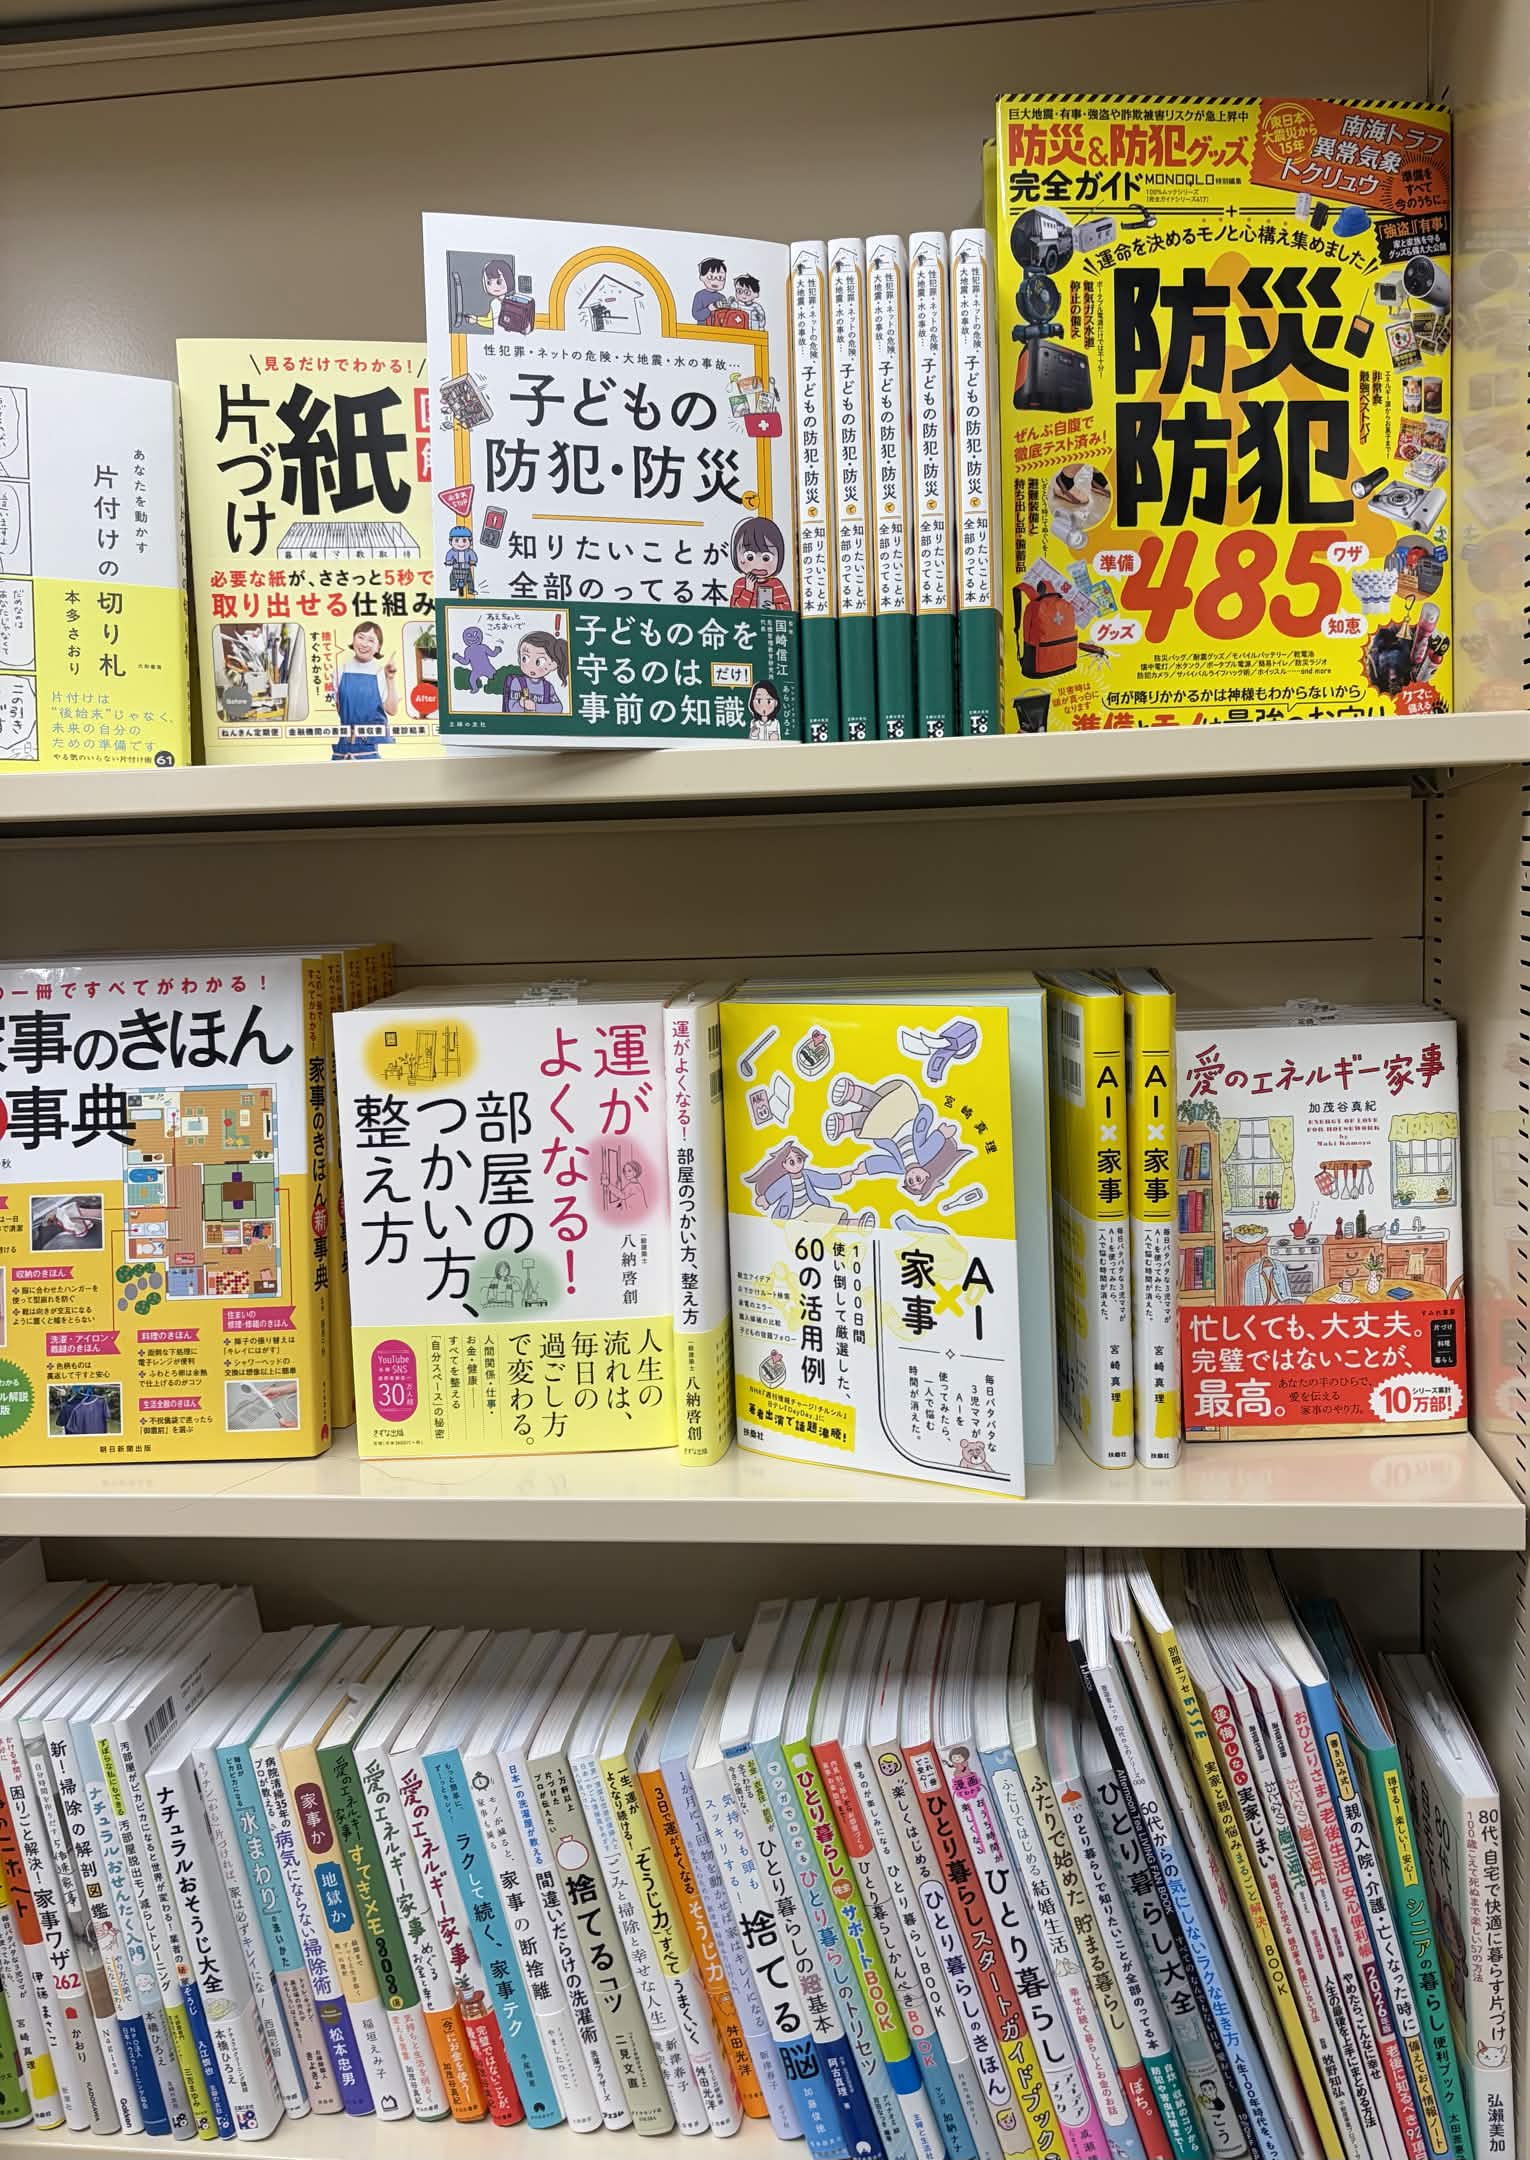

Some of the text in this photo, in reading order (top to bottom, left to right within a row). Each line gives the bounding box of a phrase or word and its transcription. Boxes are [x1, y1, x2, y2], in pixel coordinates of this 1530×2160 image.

[1008, 123, 1249, 167] 防災&防犯グッズ
[1279, 141, 1305, 155] 15年
[1280, 157, 1380, 195] トクリュウ
[1312, 136, 1402, 174] 異常気象
[1341, 115, 1444, 154] 南海トラフ
[1009, 169, 1144, 203] 完全ガイド
[264, 356, 414, 374] 見るだけでわかる！
[1114, 267, 1350, 395] 防災
[510, 373, 717, 431] 子どもの
[801, 366, 820, 504] 子どもの防犯・防災
[840, 363, 858, 503] 子どもの防犯・防災
[879, 361, 897, 500] 子どもの防犯・防災
[921, 358, 939, 498] 子どもの防犯・防災
[964, 355, 983, 495] 子どもの防犯・防災
[1014, 415, 1095, 443] ぜんぶ自腹で
[215, 384, 276, 556] 片づけ
[277, 383, 411, 516] 紙
[485, 438, 745, 504] 防犯・防災
[1114, 400, 1355, 528] 防犯
[133, 449, 148, 553] あなたを動かす
[93, 464, 126, 677] 片付けの切り札
[508, 531, 729, 566] 知りたいことが
[508, 571, 730, 606] 全部のってる本
[802, 528, 815, 611] 全部のってる本
[814, 527, 827, 612] 知りたいことが
[840, 525, 852, 609] 全部のってる本
[853, 524, 866, 610] 知りたいことが
[879, 523, 892, 607] 全部のってる本
[891, 522, 905, 608] 知りたいことが
[920, 520, 933, 604] 全部のってる本
[933, 519, 946, 605] 知りたいことが
[963, 518, 976, 603] 全部のってる本
[977, 517, 990, 602] 知りたいことが
[1099, 555, 1135, 572] 準備
[1120, 530, 1345, 643] 485
[1333, 545, 1363, 562] ワザ
[65, 590, 81, 675] 本多さおり
[212, 591, 434, 618] 取り出せる仕組み
[575, 615, 758, 650] 子どもの命を
[1097, 623, 1135, 641] グッズ
[1328, 617, 1361, 636] 知恵
[577, 654, 703, 687] 守るのは
[578, 692, 746, 728] 事前の知識
[715, 665, 750, 682] だけ！
[52, 722, 141, 737] 未来の自分の
[156, 755, 173, 766] 61
[0, 1005, 294, 1073] 事のきほん
[594, 1024, 654, 1136] 運が
[1186, 1042, 1445, 1098] 愛のエネルギー家事
[6, 1083, 136, 1151] 事典
[1308, 1100, 1377, 1113] 加茂谷真紀
[353, 1094, 414, 1265] 整え方
[475, 1091, 534, 1254] 部屋の
[540, 1028, 589, 1295] よくなる！
[672, 1020, 700, 1326] 運がよくなる！ 部屋のつかい方、整え方
[417, 1098, 479, 1318] つかい方、
[621, 1234, 639, 1305] 八納啓創
[794, 1237, 826, 1386] 60の活用例
[852, 1245, 866, 1345] 1000日間
[900, 1249, 938, 1336] 家事
[832, 1241, 852, 1399] 使い倒して厳選した、
[1189, 1310, 1422, 1343] 忙しくても、大丈夫。
[1191, 1344, 1414, 1373] 完璧ではないことが、
[378, 1383, 405, 1408] 30
[448, 1336, 461, 1409] すべてを整える
[507, 1334, 535, 1446] で変わる。
[539, 1332, 568, 1439] 過ごし方
[571, 1331, 599, 1411] 毎日の
[604, 1330, 633, 1421] 流れは、
[636, 1327, 664, 1407] 人生の
[686, 1375, 702, 1441] 八納啓創
[908, 1365, 921, 1441] 時間が消えた。
[924, 1379, 935, 1432] 一人で悩む
[938, 1371, 951, 1442] 使ってみたら、
[955, 1392, 965, 1427] AIを
[1193, 1378, 1287, 1418] 最高。
[1289, 1391, 1340, 1402] 愛を伝える
[970, 1384, 981, 1439] 3児ママが
[985, 1373, 998, 1454] 毎日バタバタな
[705, 1799, 744, 1904] スッキリする！
[721, 1792, 759, 1891] 気持ちも頭も
[796, 1770, 845, 1878] ひとり暮らし
[157, 1786, 224, 1993] ナチュラルおそうじ大全
[274, 1829, 332, 1996] 病気にならない掃除術
[400, 1768, 470, 1974] 愛のエネルギー家事
[1097, 1781, 1196, 2016] ひとり暮らし大全
[455, 1833, 524, 2038] ラクして続く、家事テク
[499, 1870, 553, 2001] 家事の断捨離
[535, 1871, 599, 2043] 間違いだらけの洗濯術
[566, 1873, 623, 2014] 捨てるコツ
[757, 1839, 834, 2035] ひとり暮らしの超基本
[886, 1865, 946, 2018] ひとり暮らしBOOK
[984, 1869, 1065, 2064] ひとり暮らし
[1478, 1808, 1506, 2042] 80代、自宅で快適に暮らす片づけ
[800, 1870, 877, 2077] ひとり暮らしのトリセツ
[925, 1891, 1008, 2097] ひとり暮らしのきほん
[328, 2027, 356, 2086] 松本忠男
